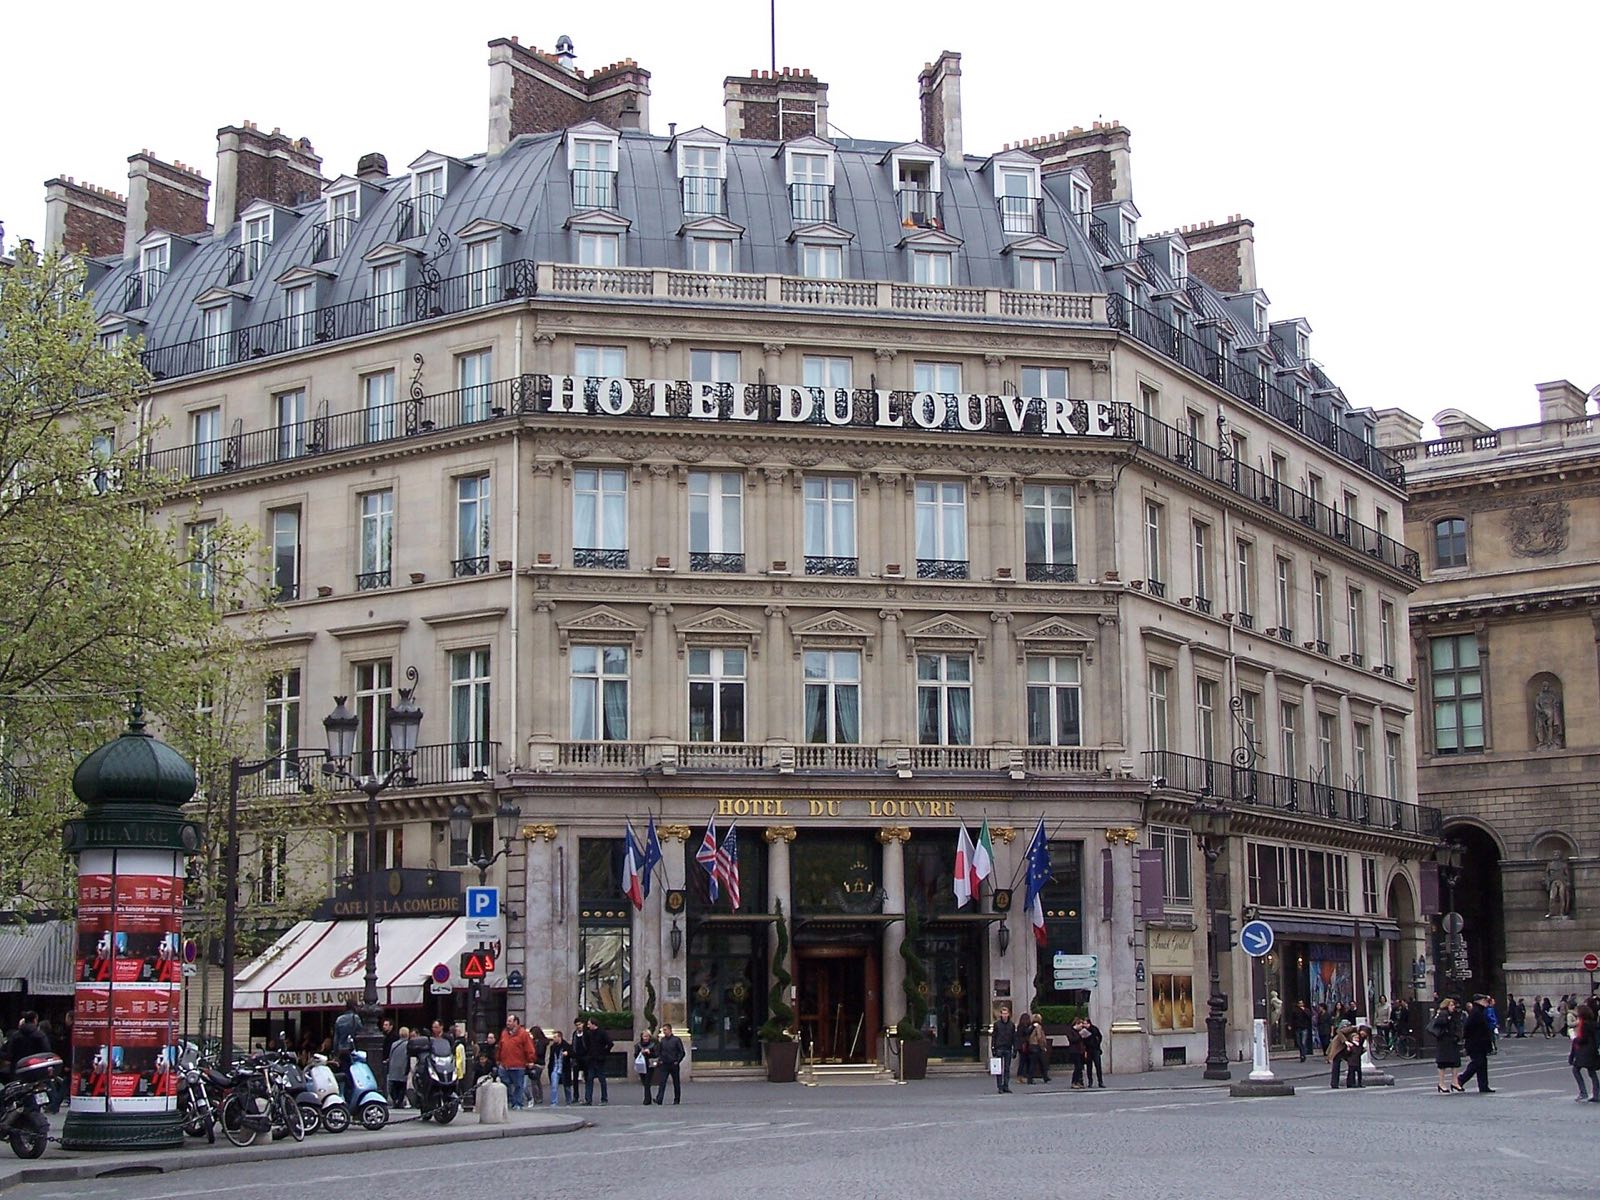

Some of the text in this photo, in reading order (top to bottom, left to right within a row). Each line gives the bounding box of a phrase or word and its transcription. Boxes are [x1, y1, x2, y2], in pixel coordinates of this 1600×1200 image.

[547, 374, 1115, 437] HOTEL DU LOUVRE
[717, 799, 958, 817] HOTEL DU LOUVRE
[383, 900, 401, 913] LA
[403, 897, 460, 912] COMEDIE
[475, 893, 491, 914] P
[278, 993, 302, 1005] CAFE
[305, 992, 318, 1004] DE
[321, 991, 334, 1003] LA
